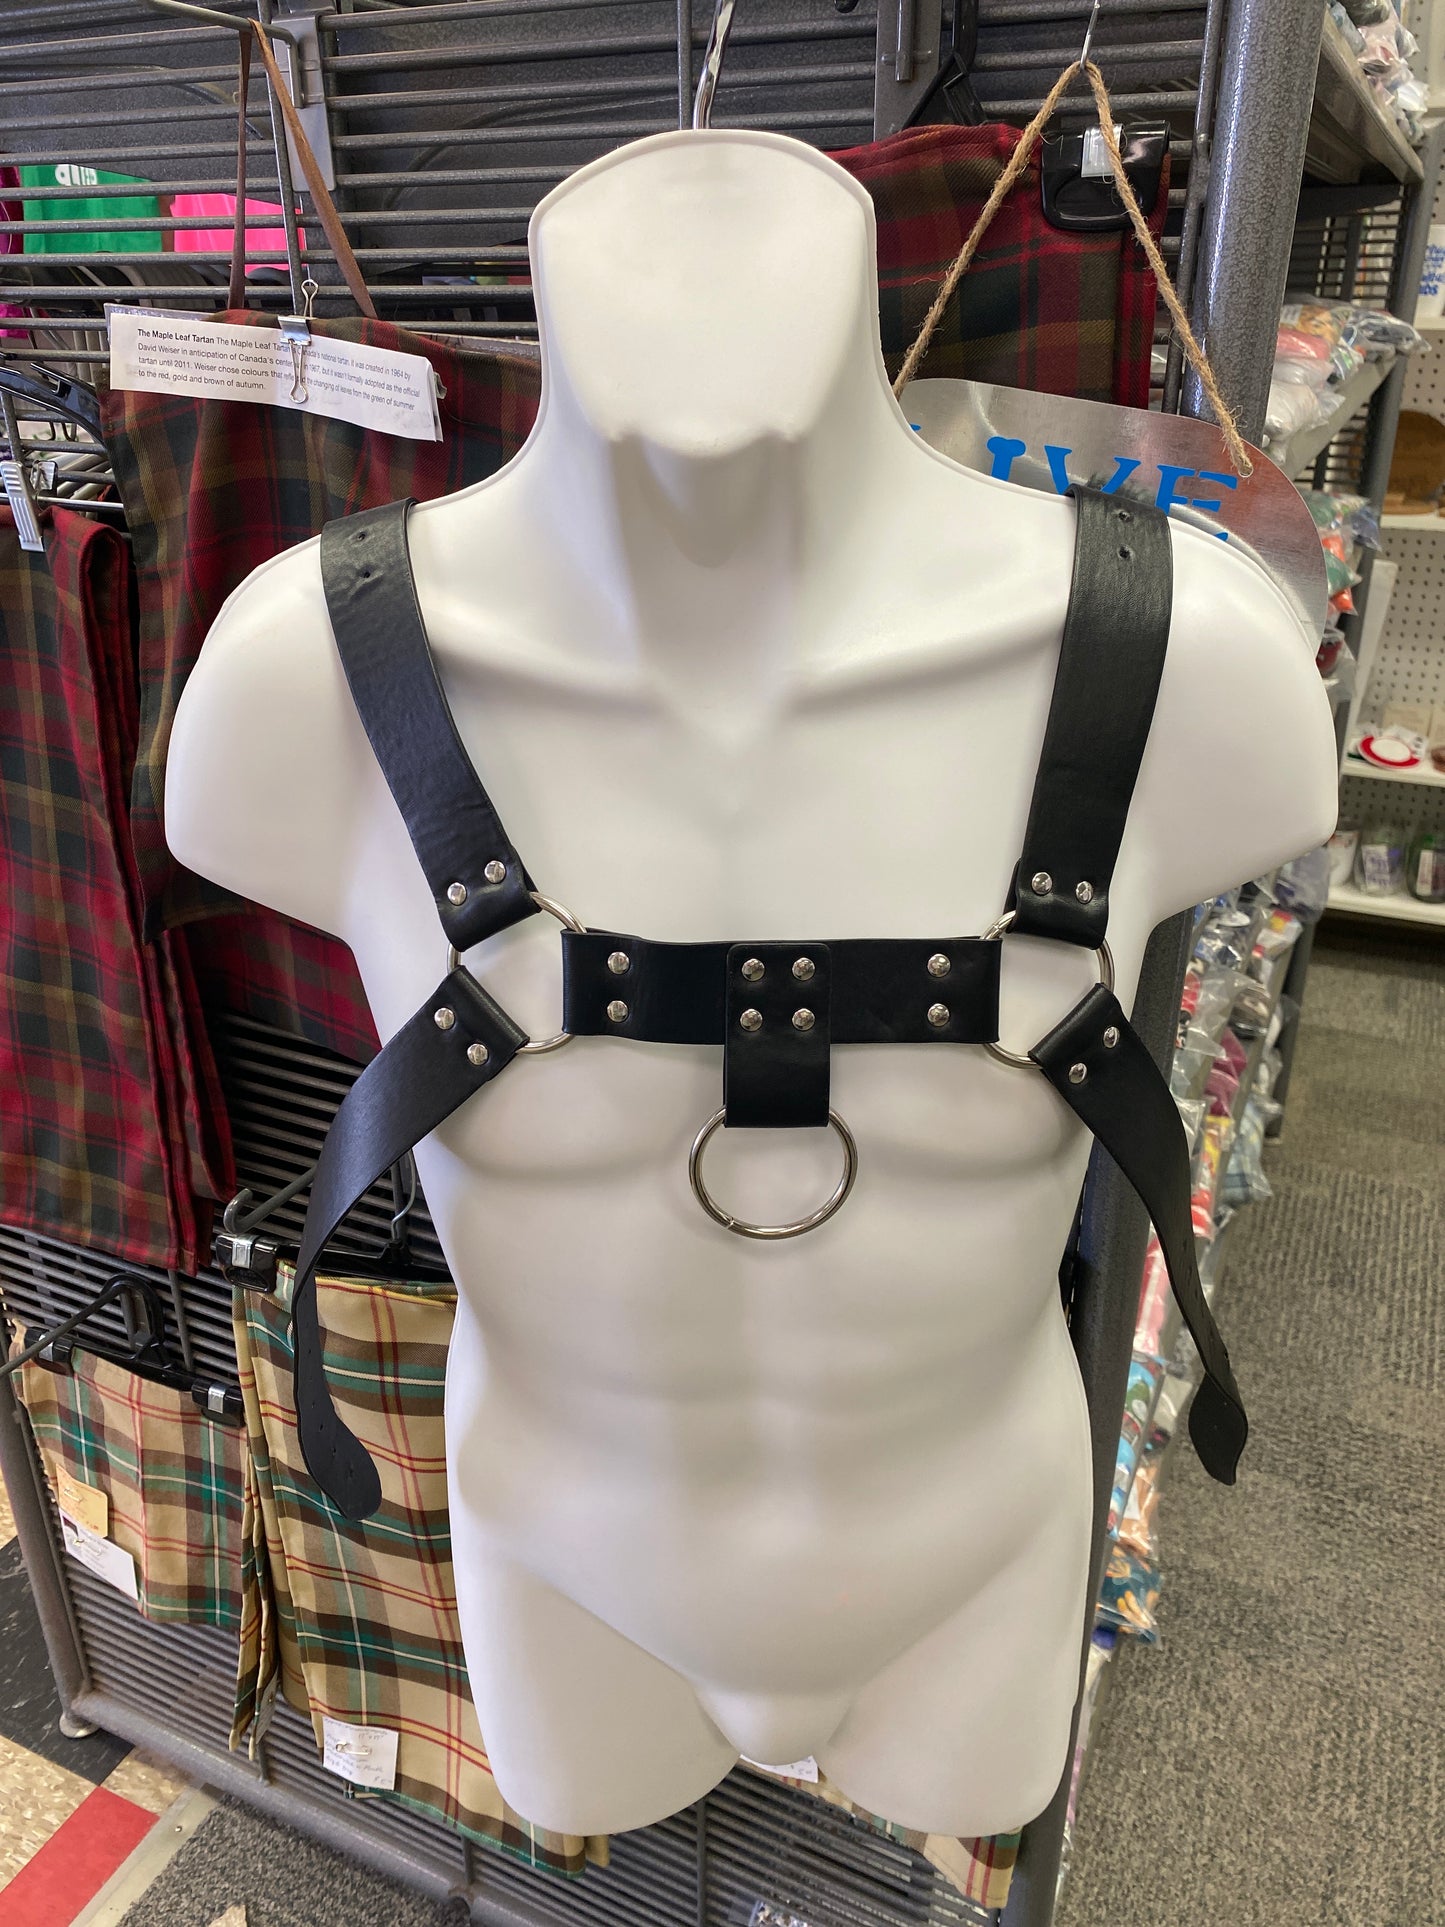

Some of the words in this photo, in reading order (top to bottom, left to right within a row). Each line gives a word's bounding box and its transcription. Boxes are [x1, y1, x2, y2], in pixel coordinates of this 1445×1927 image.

[138, 328, 150, 338] The
[152, 330, 173, 340] Maple
[174, 332, 190, 342] Leaf
[192, 334, 214, 344] Tartan
[216, 336, 229, 346] The
[230, 338, 252, 348] Maple
[254, 342, 270, 350] Leaf
[365, 364, 384, 374] created
[391, 368, 404, 378] 1964
[404, 372, 410, 381] by
[138, 342, 156, 352] David
[158, 345, 180, 354] Weiser
[189, 350, 228, 360] anticipation
[238, 354, 274, 364] Canada's
[322, 367, 330, 376] but
[364, 378, 385, 390] adopted
[386, 384, 392, 392] as
[394, 384, 402, 394] the
[138, 356, 158, 364] tartan
[159, 358, 173, 366] until
[174, 360, 192, 368] 2011.
[194, 362, 216, 371] Weiser
[218, 366, 240, 374] chose
[241, 368, 270, 377] colours
[270, 370, 282, 378] that
[335, 384, 340, 392] of
[362, 391, 370, 400] the
[371, 394, 385, 403] green
[393, 400, 414, 410] summer
[158, 372, 170, 380] red,
[172, 374, 188, 382] gold
[204, 377, 224, 386] brown
[236, 381, 266, 390] autumn.
